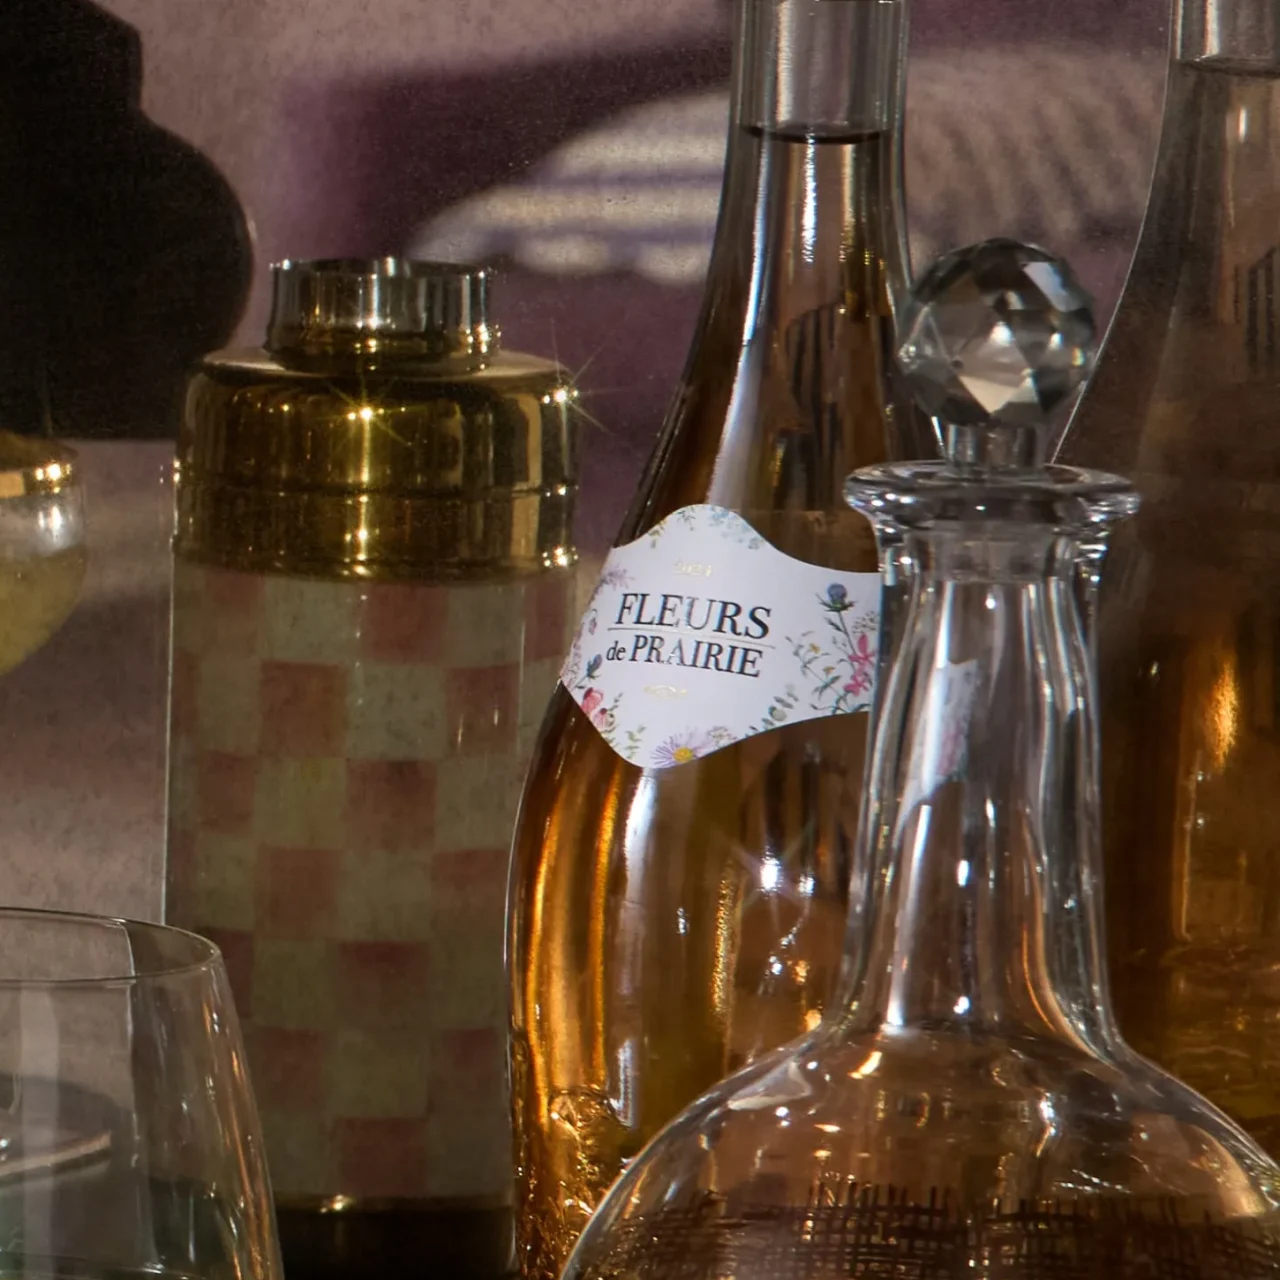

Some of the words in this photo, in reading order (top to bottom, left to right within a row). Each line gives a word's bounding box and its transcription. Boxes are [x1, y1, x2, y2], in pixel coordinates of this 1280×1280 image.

[615, 593, 772, 640] FLEURS
[606, 640, 626, 662] de
[629, 635, 763, 678] PRAIRIE
